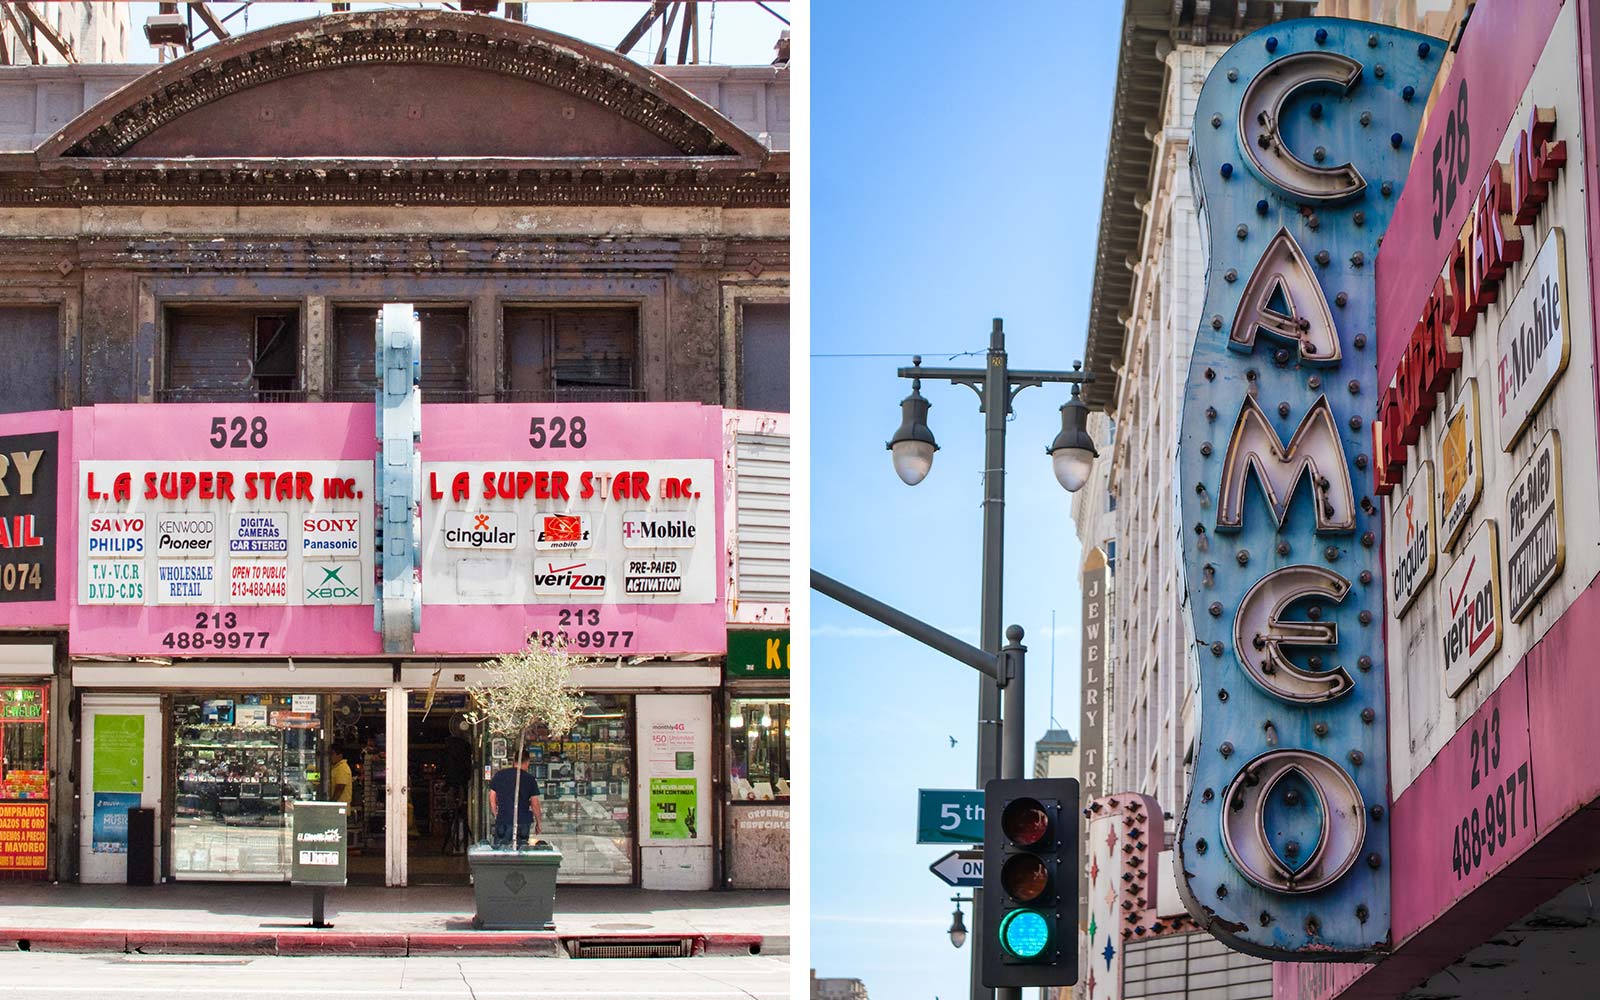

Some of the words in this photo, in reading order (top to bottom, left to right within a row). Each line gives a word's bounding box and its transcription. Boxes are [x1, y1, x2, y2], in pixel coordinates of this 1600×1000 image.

[1432, 78, 1471, 241] 528
[210, 416, 268, 449] 528
[529, 416, 587, 449] 528
[1215, 51, 1367, 895] CAMEO
[144, 471, 235, 502] SUPER
[245, 471, 314, 502] STAR
[452, 471, 469, 502] A
[483, 471, 570, 502] SUPER
[580, 471, 651, 502] STAR
[1510, 447, 1551, 543] PRE-PAIED
[159, 520, 213, 533] KENWOOD
[241, 518, 275, 527] DIGITAL
[304, 519, 358, 532] SONY
[159, 534, 212, 549] Pioneer
[238, 528, 280, 538] CAMERAS
[446, 526, 516, 547] cingular
[89, 538, 144, 551] PHILIPS
[231, 541, 250, 550] CAR
[252, 541, 286, 550] STEREO
[303, 538, 358, 549] Panasonic
[629, 561, 677, 574] PRE-PAIED
[1394, 520, 1429, 602] cingular
[1511, 508, 1558, 612] ACTIVATION
[0, 563, 41, 591] 074
[159, 566, 213, 580] WHOLESALE
[232, 566, 250, 579] OPEN
[252, 566, 261, 579] TO
[262, 566, 286, 579] PUBLIC
[534, 571, 606, 591] verizon
[170, 583, 202, 596] RETAIL
[232, 581, 286, 596] 213-488-0448
[306, 586, 359, 599] XBOX
[626, 578, 680, 592] ACTIVATION
[195, 612, 237, 629] 213
[559, 609, 600, 626] 213
[1443, 579, 1495, 671] verizon
[162, 632, 270, 649] 488-9977
[1086, 580, 1100, 727] JEWELRY
[1470, 707, 1501, 790] 213
[21, 818, 30, 829] DE
[941, 803, 984, 830] 5th
[1453, 761, 1528, 881] 488-9977
[26, 831, 45, 842] PRECIO
[5, 842, 45, 853] MAYOREO
